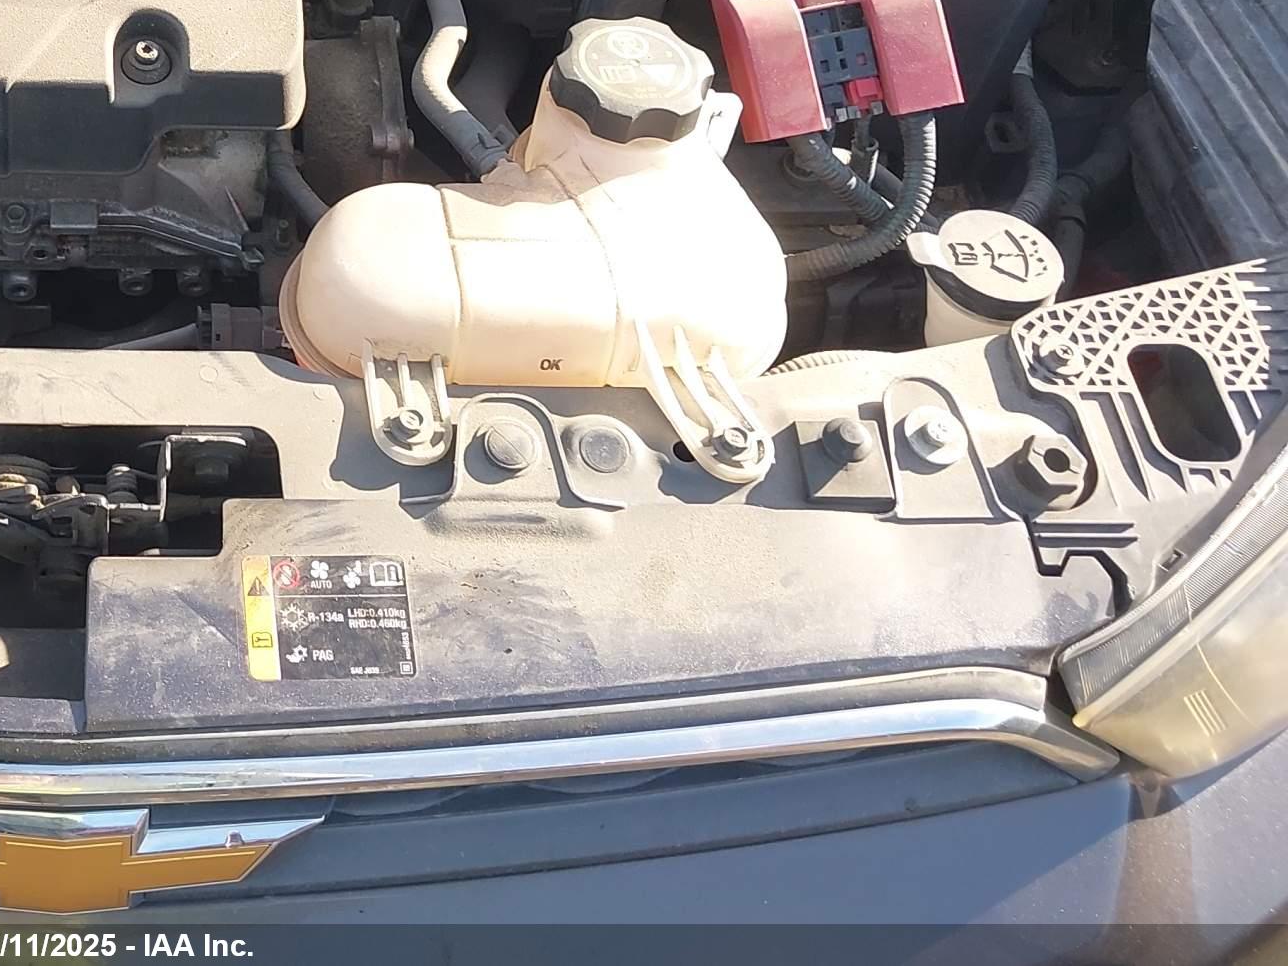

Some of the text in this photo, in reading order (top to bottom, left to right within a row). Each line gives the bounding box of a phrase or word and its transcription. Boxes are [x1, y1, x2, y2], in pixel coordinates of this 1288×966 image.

[540, 358, 564, 371] OK
[311, 579, 332, 589] AUTO
[307, 611, 344, 623] R-134a
[312, 649, 334, 661] PAG
